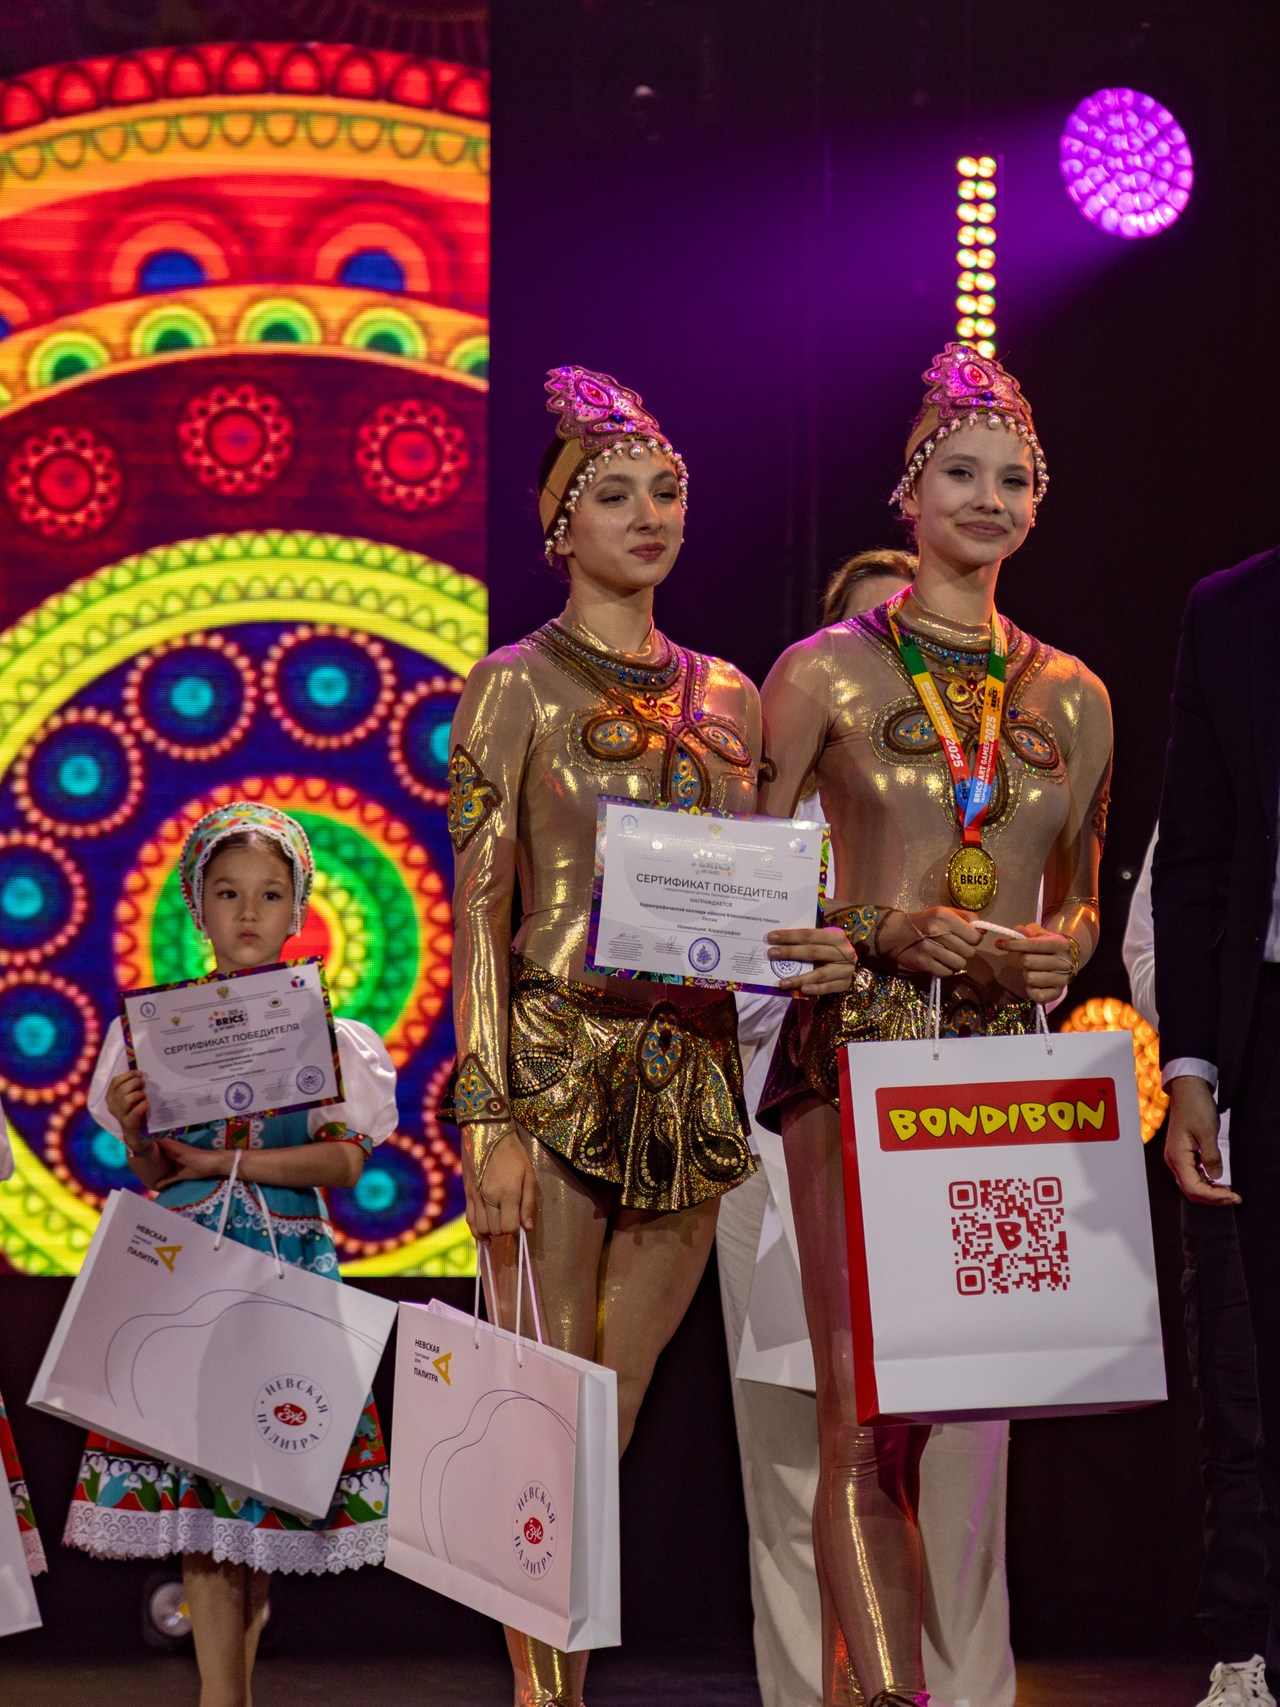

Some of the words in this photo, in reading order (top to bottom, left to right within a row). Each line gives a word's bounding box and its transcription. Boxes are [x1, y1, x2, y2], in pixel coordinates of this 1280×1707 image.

[982, 715, 997, 742] 2025
[944, 737, 964, 768] 2025
[980, 741, 990, 764] GAMES
[977, 765, 986, 780] ART
[973, 780, 983, 803] BRICS
[636, 872, 710, 891] СЕРТИФИКАТ
[713, 882, 788, 901] ПОБЕДИТЕЛЯ
[960, 875, 989, 885] BRICS
[690, 897, 732, 907] НАГРАЖДАЕТСЯ
[215, 1014, 244, 1026] BRICS
[164, 1035, 230, 1055] СЕРТИФИКАТ
[232, 1022, 299, 1042] ПОБЕДИТЕЛЯ
[888, 1100, 1106, 1141] BONDIBON
[136, 1224, 167, 1243] НЕВСКАЯ
[127, 1246, 158, 1266] ПАЛИТРА
[415, 1339, 440, 1354] НЕВСКАЯ
[414, 1367, 438, 1383] ПАЛИТРА
[265, 1378, 328, 1413] НЕВСКАЯ
[257, 1414, 319, 1450] ПАЛИТРА
[518, 1487, 555, 1524] НЕВСКАЯ
[514, 1536, 552, 1574] ПАЛИТРА
